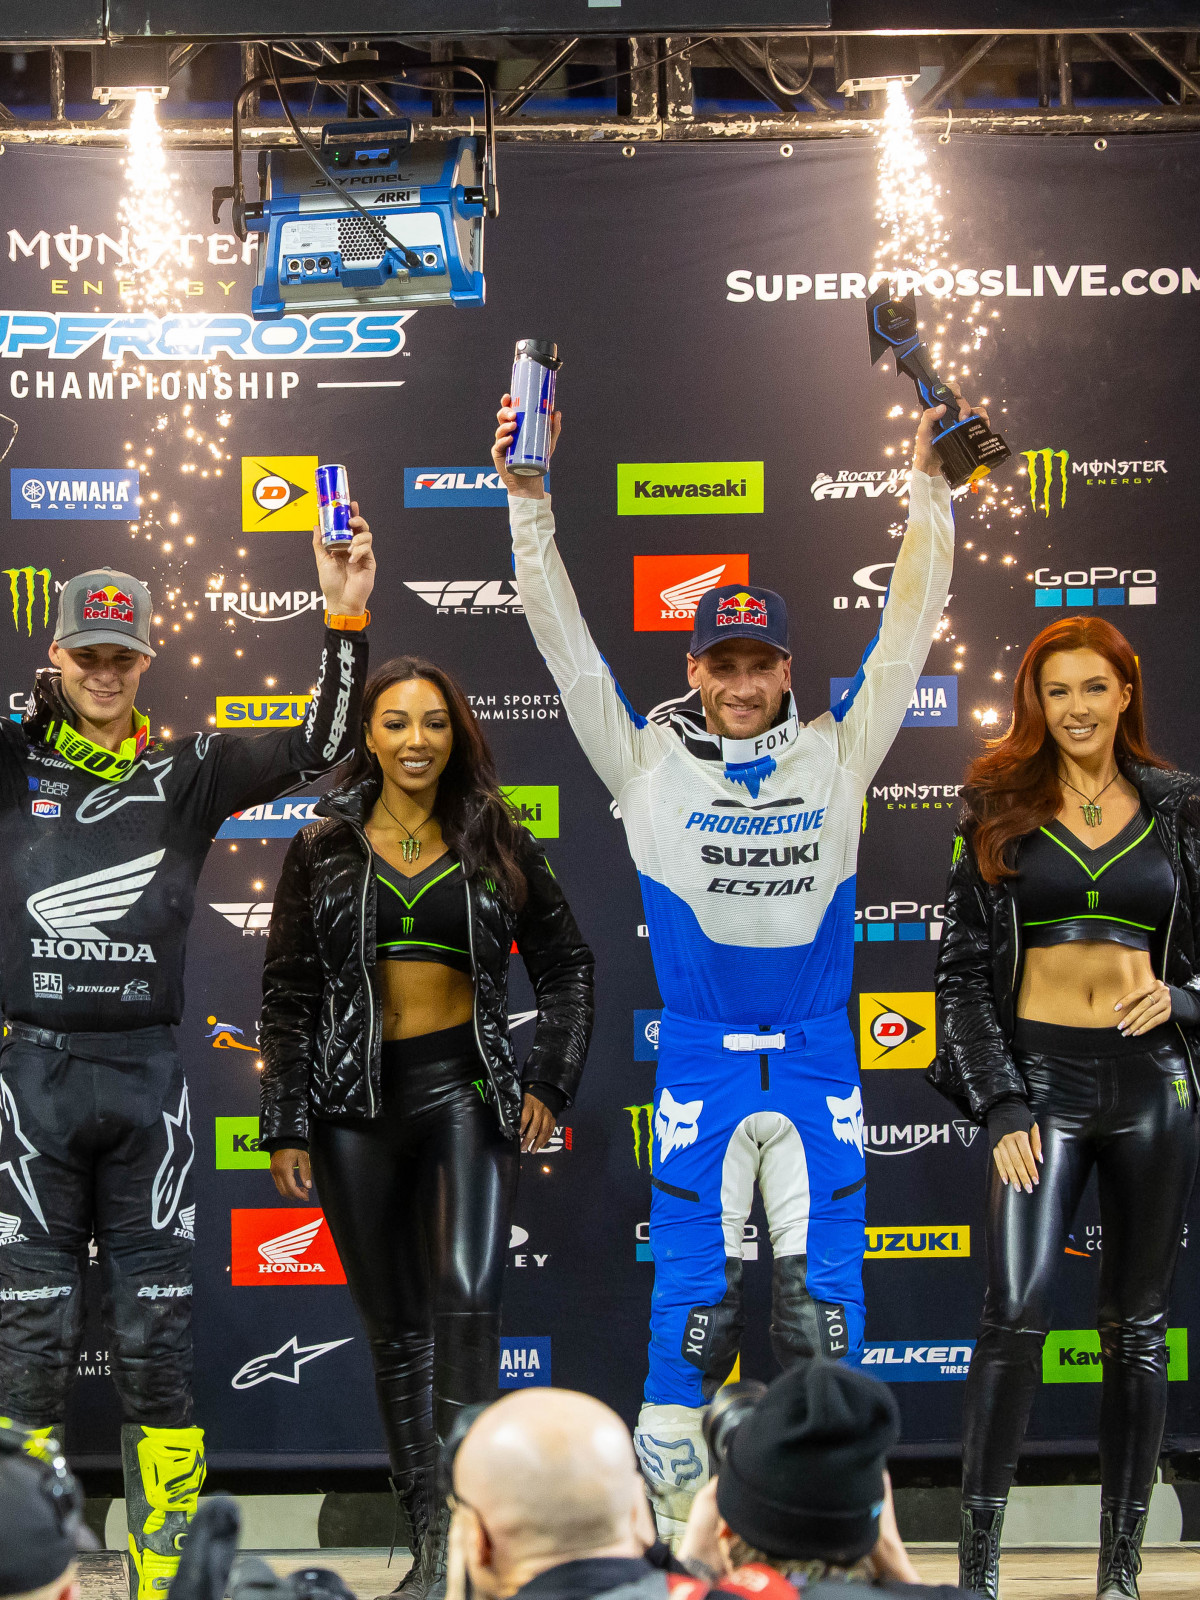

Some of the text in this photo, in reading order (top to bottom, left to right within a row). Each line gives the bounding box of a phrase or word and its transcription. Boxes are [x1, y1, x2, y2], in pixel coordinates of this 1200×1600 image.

[374, 191, 411, 203] ARRI
[6, 224, 258, 272] MONTE
[51, 279, 237, 296] ENEGY
[10, 370, 300, 400] CHAMPIONSHIP
[836, 470, 887, 482] ROCKY
[1072, 458, 1168, 481] MONSTER
[46, 480, 129, 502] YAMAHA
[412, 473, 508, 490] FALK
[634, 478, 747, 499] Kawasaki
[1086, 477, 1153, 486] ENERGY
[1034, 567, 1157, 586] GoPro
[204, 590, 328, 621] TRIUMPH
[436, 607, 525, 615] RACING
[660, 609, 697, 620] HON
[83, 606, 134, 625] Red Bull
[716, 612, 768, 628] Red Bull
[467, 694, 560, 706] TAH SPORTS
[907, 687, 948, 709] AHA
[225, 701, 311, 721] SUZU
[471, 708, 559, 720] OMMISSION
[754, 727, 790, 756] FOX
[58, 730, 135, 780] 100%
[39, 786, 69, 797] LOCK
[40, 779, 70, 791] QUAD
[35, 803, 58, 815] 100%
[237, 803, 327, 821] ALK
[887, 802, 954, 810] ENERGY
[685, 807, 825, 836] PROGRESSIVE
[700, 841, 820, 868] SUZUKI
[706, 875, 818, 897] ECSTAR
[30, 937, 157, 964] HONDA
[75, 985, 121, 993] DUNLOP
[862, 1123, 950, 1155] IUMPH
[866, 1232, 959, 1253] UZUKI
[258, 1263, 326, 1274] HONDA
[685, 1312, 709, 1356] FOX
[825, 1308, 845, 1352] FOX
[501, 1348, 540, 1369] AHA
[861, 1346, 973, 1364] ALKEN
[940, 1365, 969, 1375] TIRES
